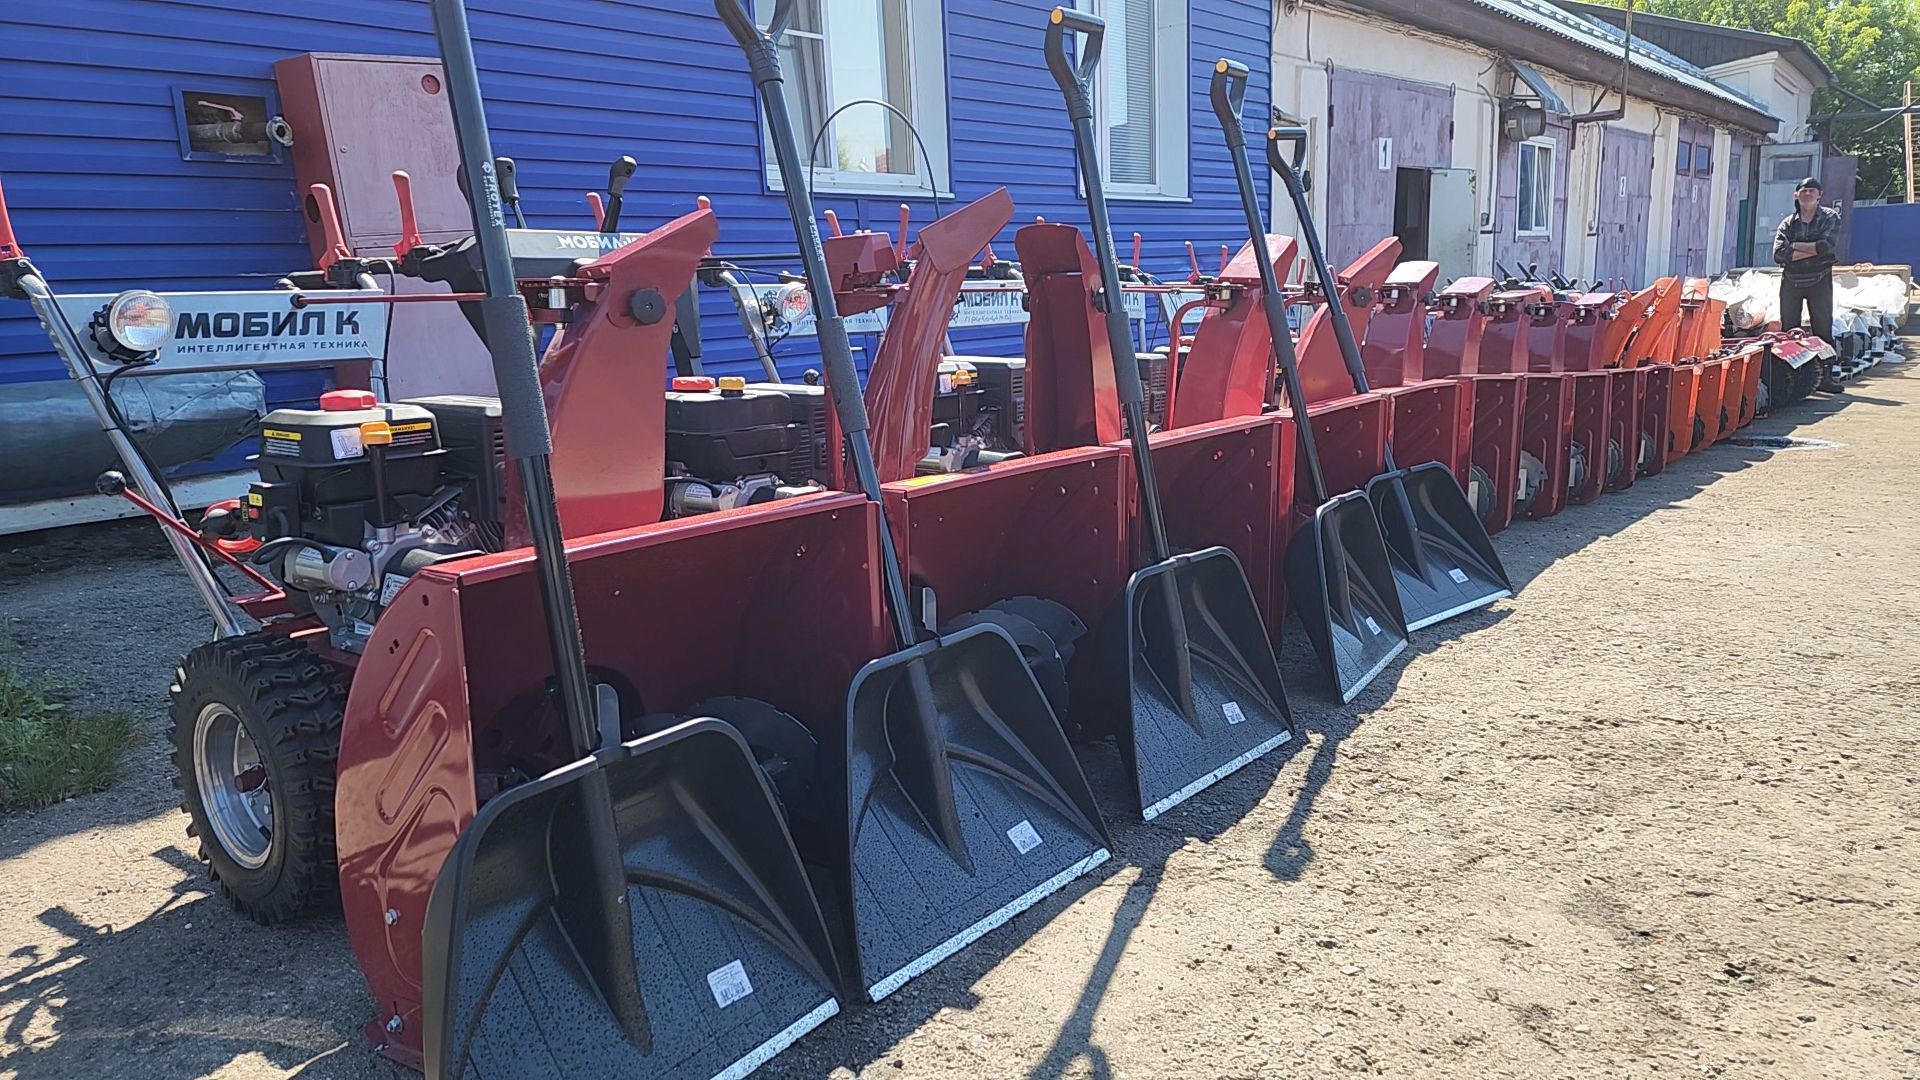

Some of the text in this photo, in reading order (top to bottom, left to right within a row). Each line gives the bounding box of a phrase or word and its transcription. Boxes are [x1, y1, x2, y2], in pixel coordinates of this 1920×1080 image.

[1382, 140, 1388, 167] 1
[486, 175, 503, 226] PROTEX
[1833, 200, 1842, 215] 5
[963, 292, 1008, 307] МОБИЛ
[174, 310, 360, 339] МОБИЛ К
[176, 340, 369, 354] ИНТЕЛЛИГЕНТНАЯ ТЕХНИКА
